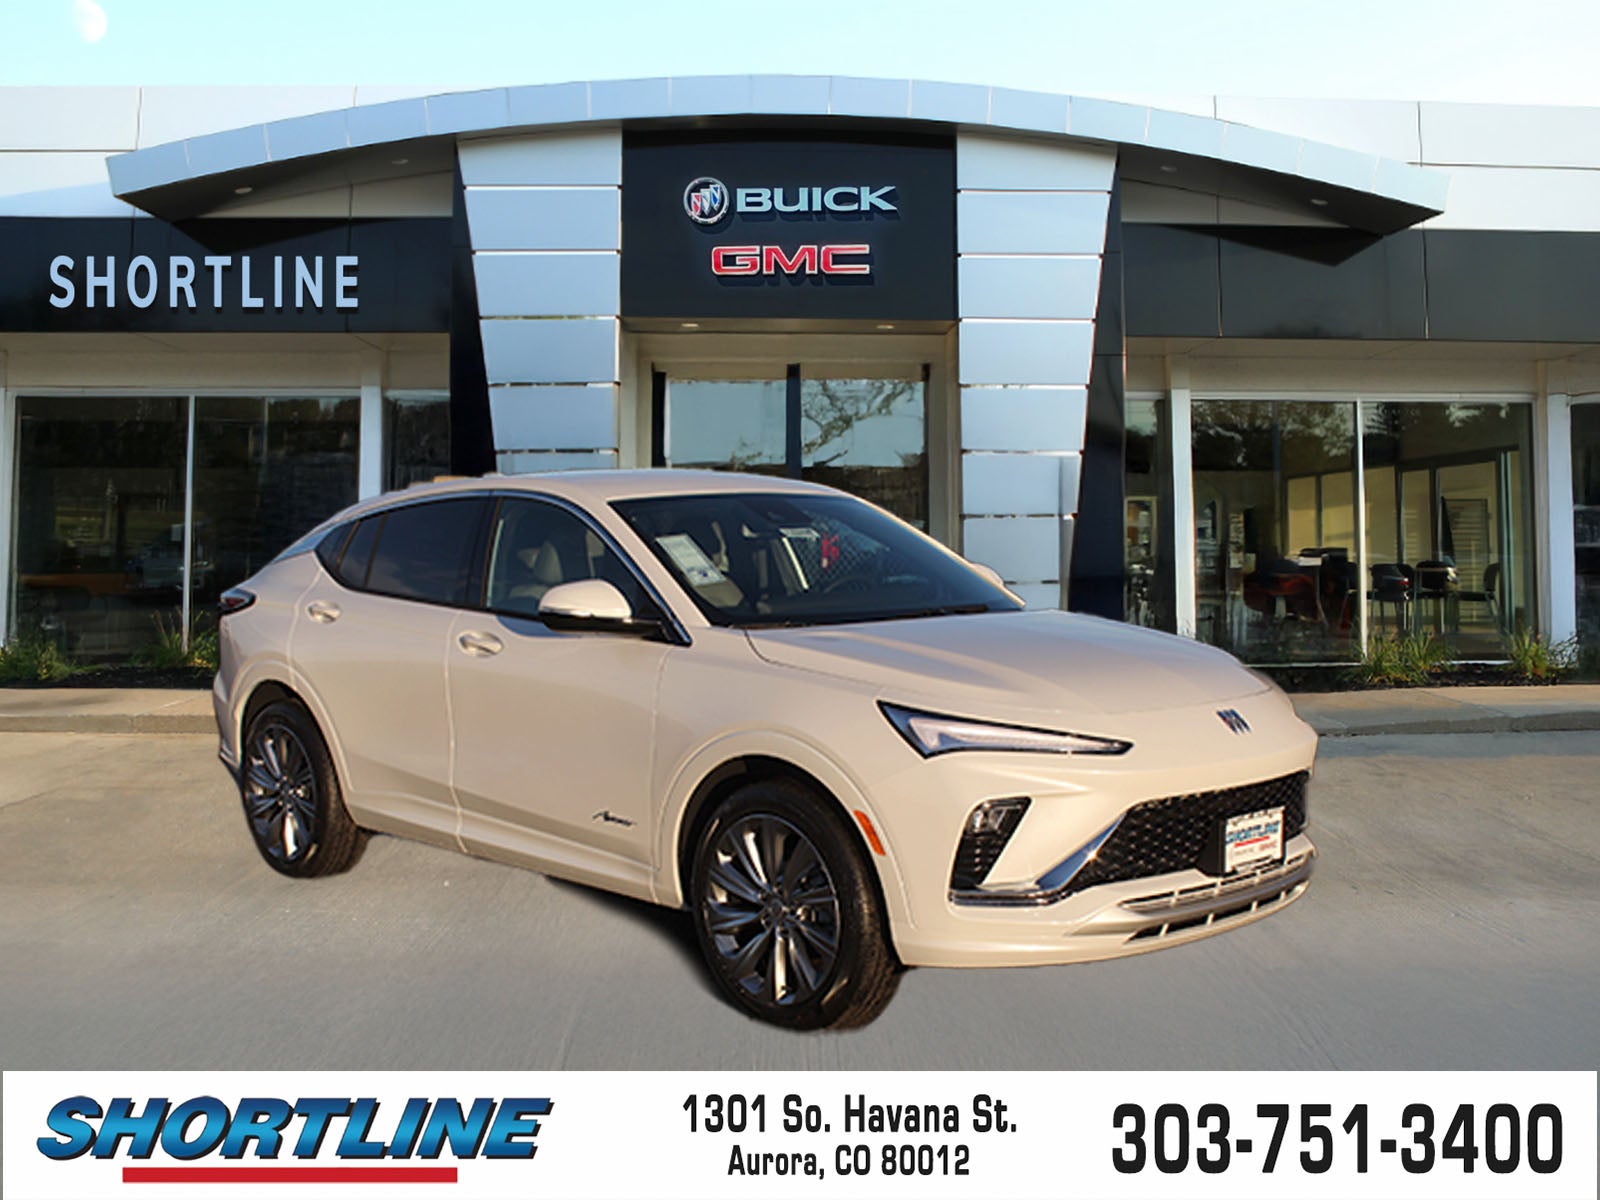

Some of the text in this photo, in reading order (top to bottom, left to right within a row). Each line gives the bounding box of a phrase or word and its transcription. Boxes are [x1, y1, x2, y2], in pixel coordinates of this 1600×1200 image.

[737, 187, 898, 212] BUICK
[712, 245, 870, 275] GMC
[50, 256, 359, 308] SHORTLINE
